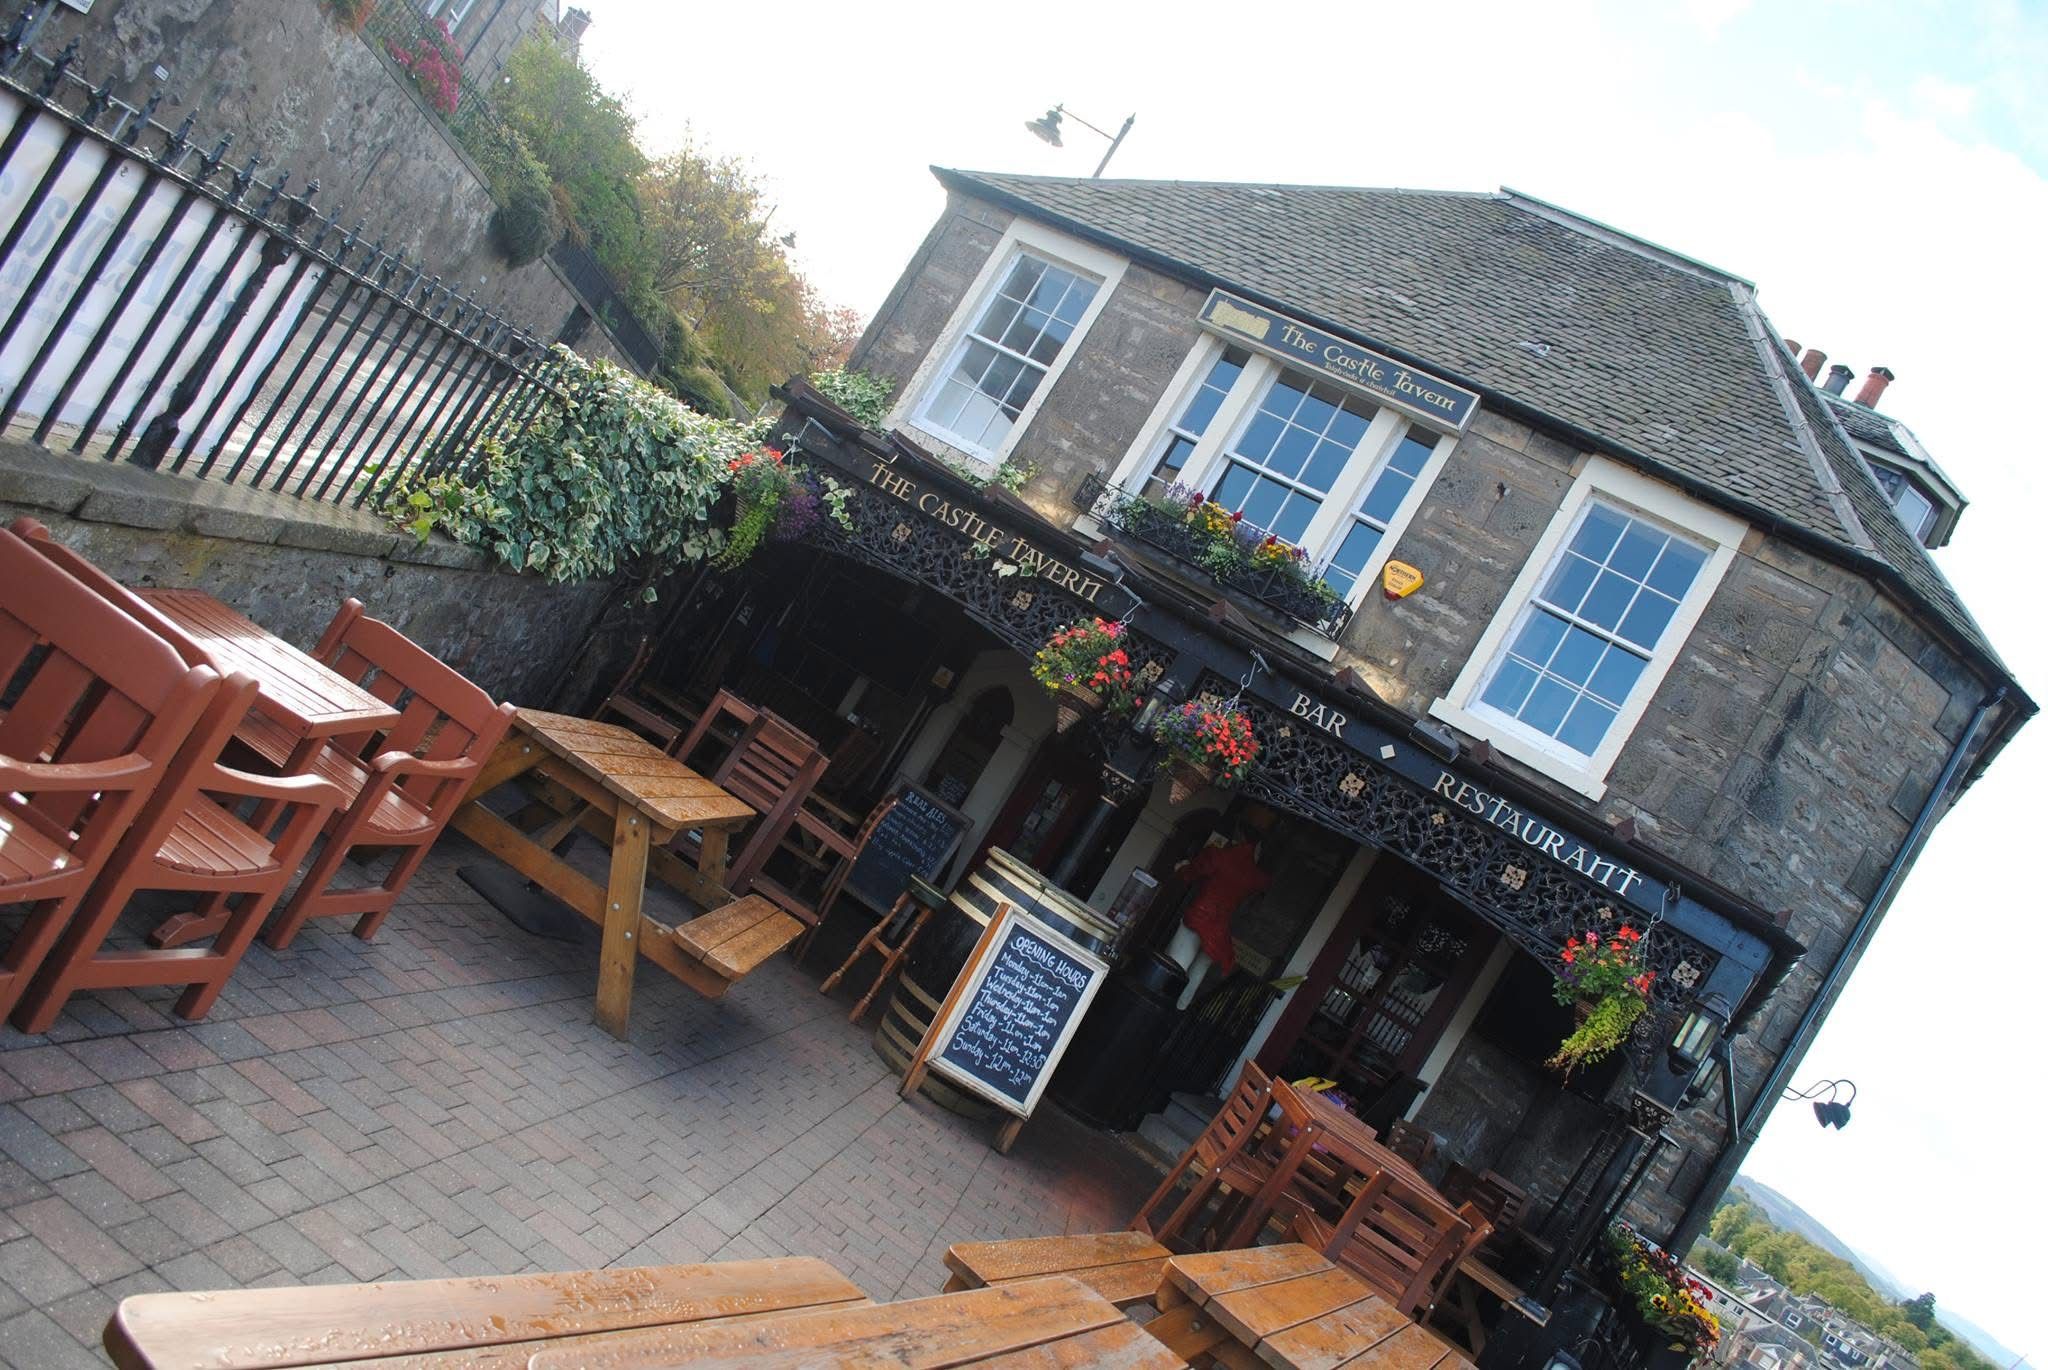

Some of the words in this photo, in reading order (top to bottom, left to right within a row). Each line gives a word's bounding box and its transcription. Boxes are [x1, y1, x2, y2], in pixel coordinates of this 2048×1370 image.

[1282, 323, 1318, 353] The
[1323, 345, 1385, 382] Castle
[1393, 370, 1457, 412] Tavern
[871, 463, 917, 502] THE
[918, 492, 1005, 549] CASTLE
[1010, 537, 1104, 603] TAVERN
[905, 791, 929, 812] REAL
[1287, 692, 1349, 739] BAR
[1432, 770, 1644, 897] RESTAURANT
[1015, 936, 1055, 968] OPENING
[1056, 960, 1088, 989] HOURS
